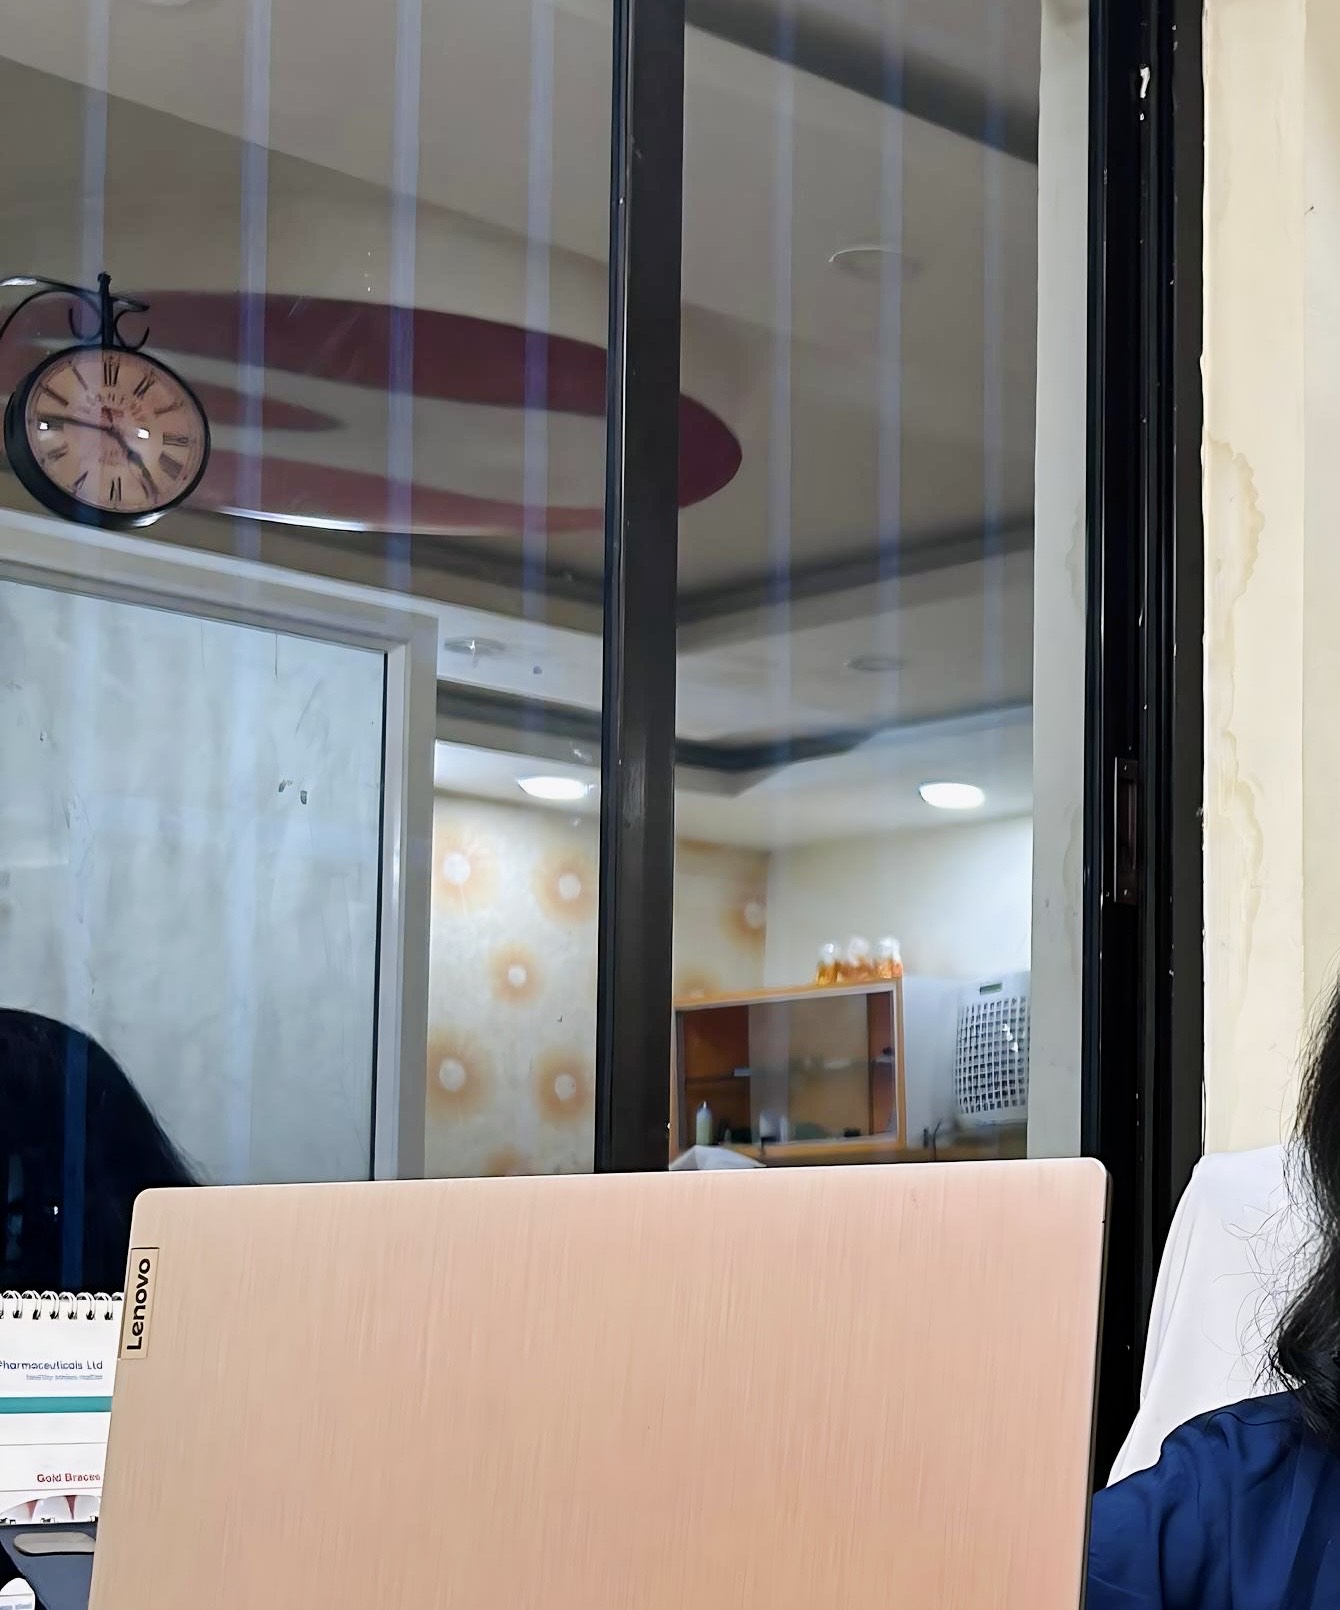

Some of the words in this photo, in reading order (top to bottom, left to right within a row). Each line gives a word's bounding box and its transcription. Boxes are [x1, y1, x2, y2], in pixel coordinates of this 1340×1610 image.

[126, 1258, 151, 1351] Lenovo
[86, 1360, 103, 1370] Ltd
[36, 1473, 62, 1483] Gold
